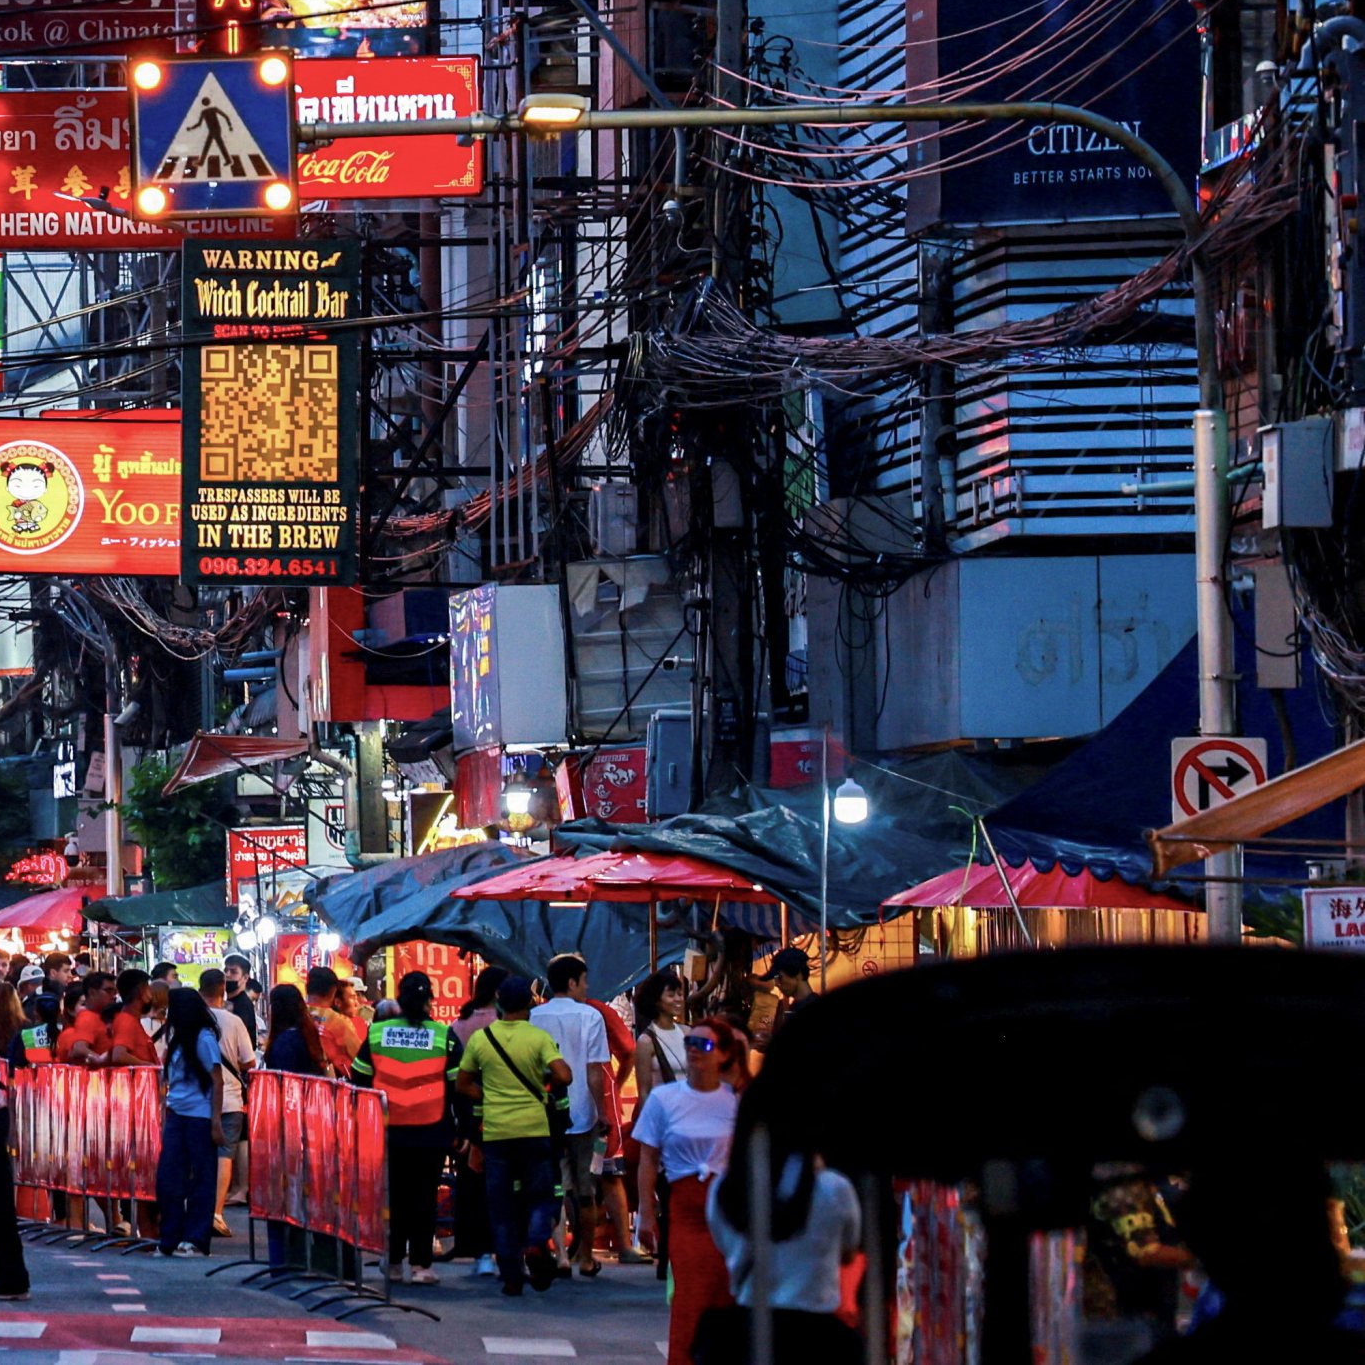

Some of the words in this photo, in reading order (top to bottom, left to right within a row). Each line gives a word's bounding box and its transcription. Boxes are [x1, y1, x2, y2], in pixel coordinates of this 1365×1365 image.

[44, 19, 69, 47] @
[52, 95, 130, 152] ลิ้ม
[1014, 170, 1064, 185] BETTER
[1069, 166, 1120, 182] STARTS
[1128, 166, 1153, 179] NO
[0, 212, 59, 236] HENG
[202, 249, 319, 271] WARNING
[193, 277, 242, 318] Witch
[246, 278, 311, 319] Cocktail
[314, 279, 349, 319] Bar
[214, 324, 248, 338] SCAN
[92, 488, 161, 525] YOO
[198, 487, 285, 504] TRESPASSERS
[288, 487, 321, 504] WILL
[323, 488, 340, 504] BE
[191, 504, 228, 522] USED
[230, 505, 249, 521] AS
[251, 505, 347, 522] INGREDIENTS
[197, 524, 222, 549] IN
[227, 525, 272, 549] THE
[277, 525, 340, 549] BREW
[199, 556, 338, 577] 096.324.6541
